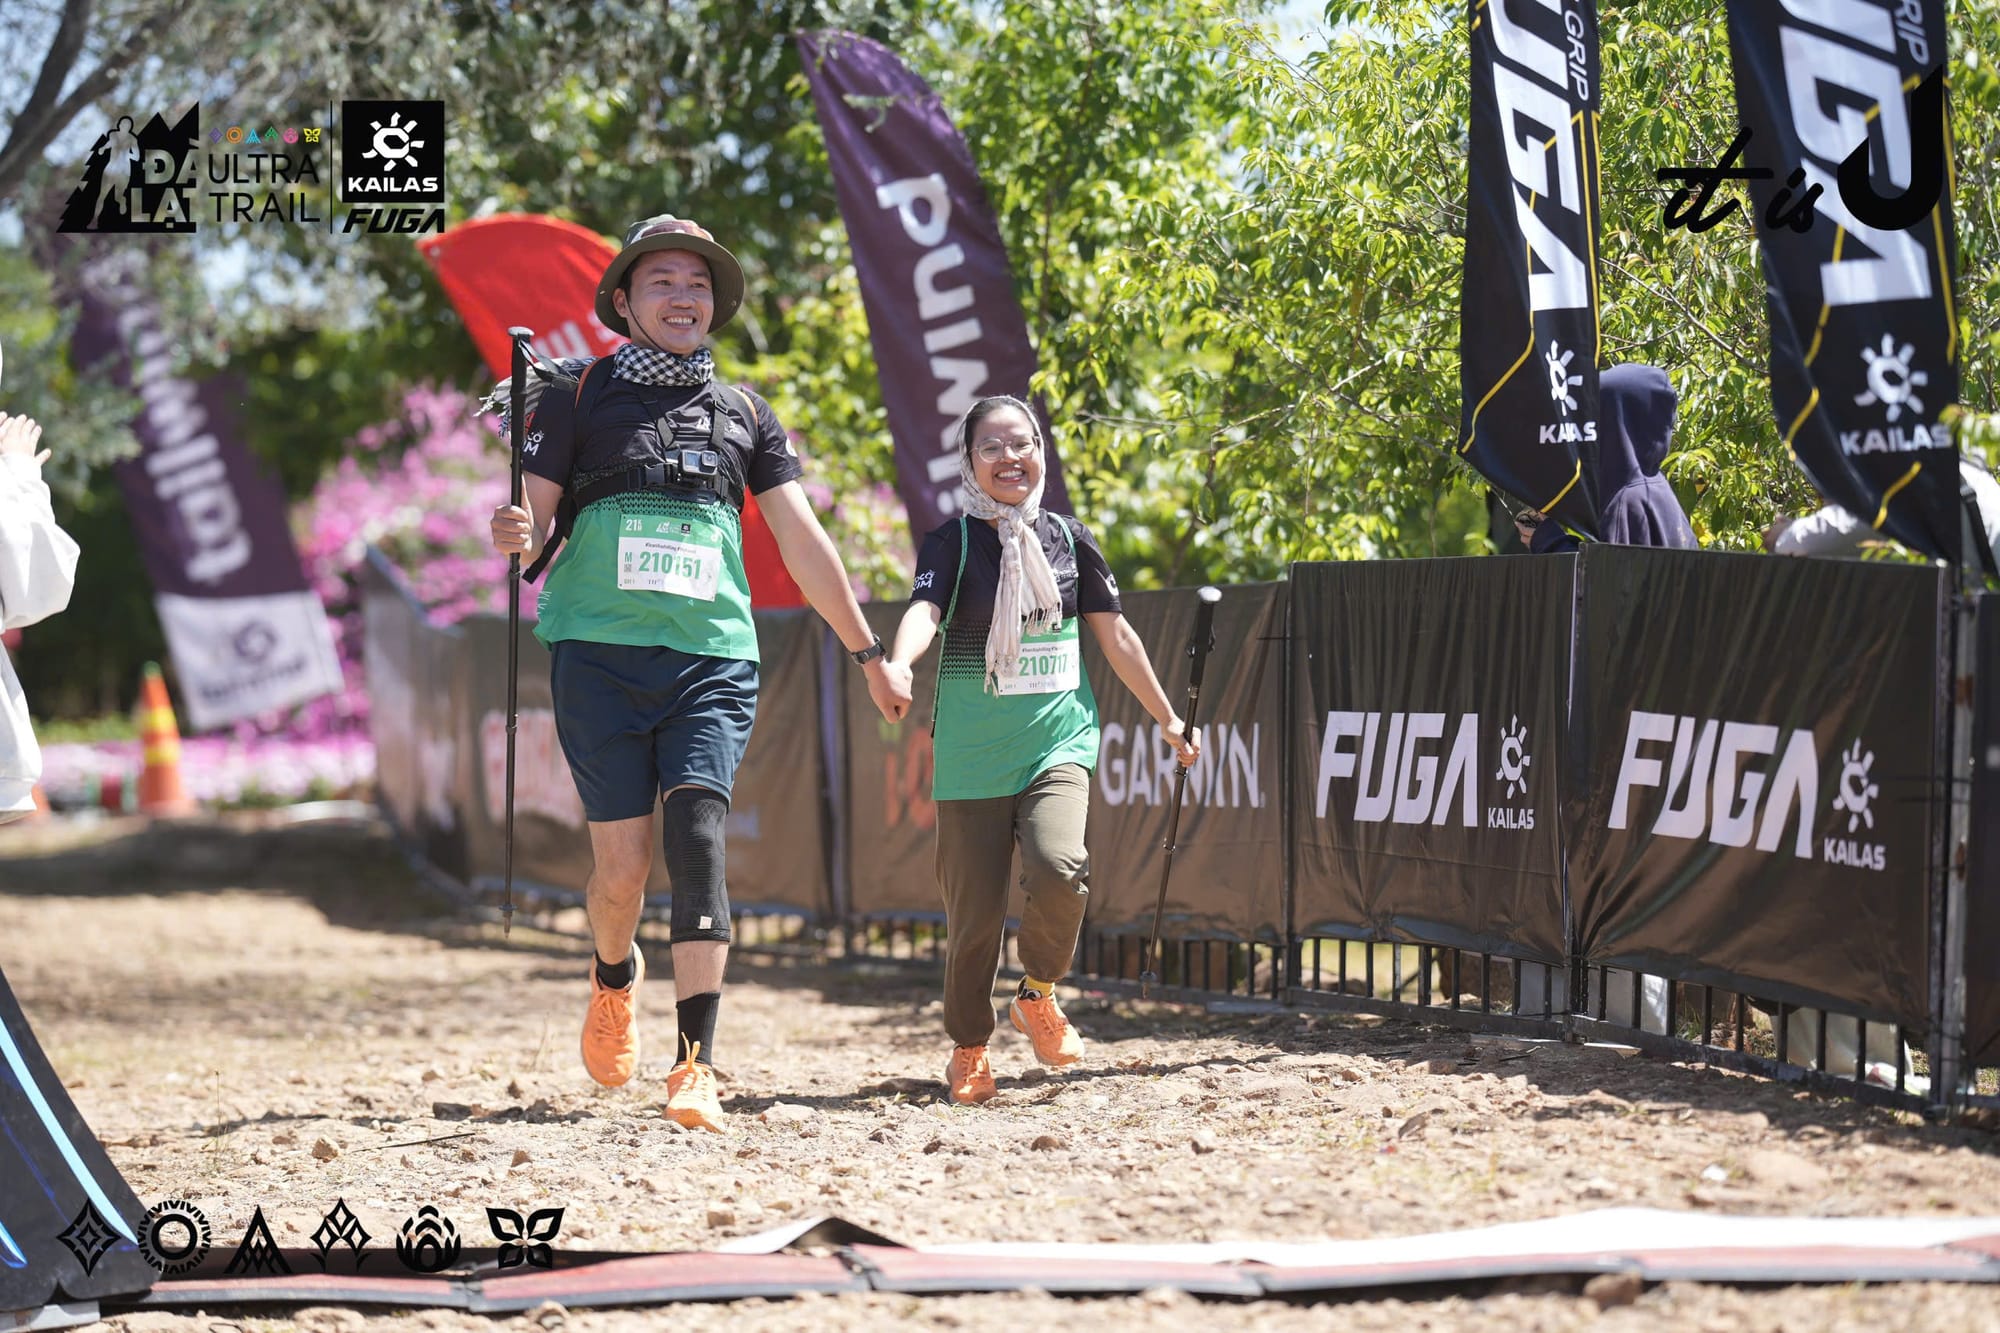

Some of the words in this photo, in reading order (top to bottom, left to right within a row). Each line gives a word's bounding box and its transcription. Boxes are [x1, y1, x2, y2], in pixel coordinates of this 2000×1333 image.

[1565, 10, 1589, 101] GRIP
[1839, 423, 1953, 456] KAILAS
[638, 551, 702, 580] 210151
[1018, 654, 1068, 677] 210717
[1316, 711, 1479, 827] FUGA
[1607, 711, 1819, 859] FUGA
[1488, 807, 1535, 830] KAILAS
[1823, 837, 1886, 871] KAILAS
